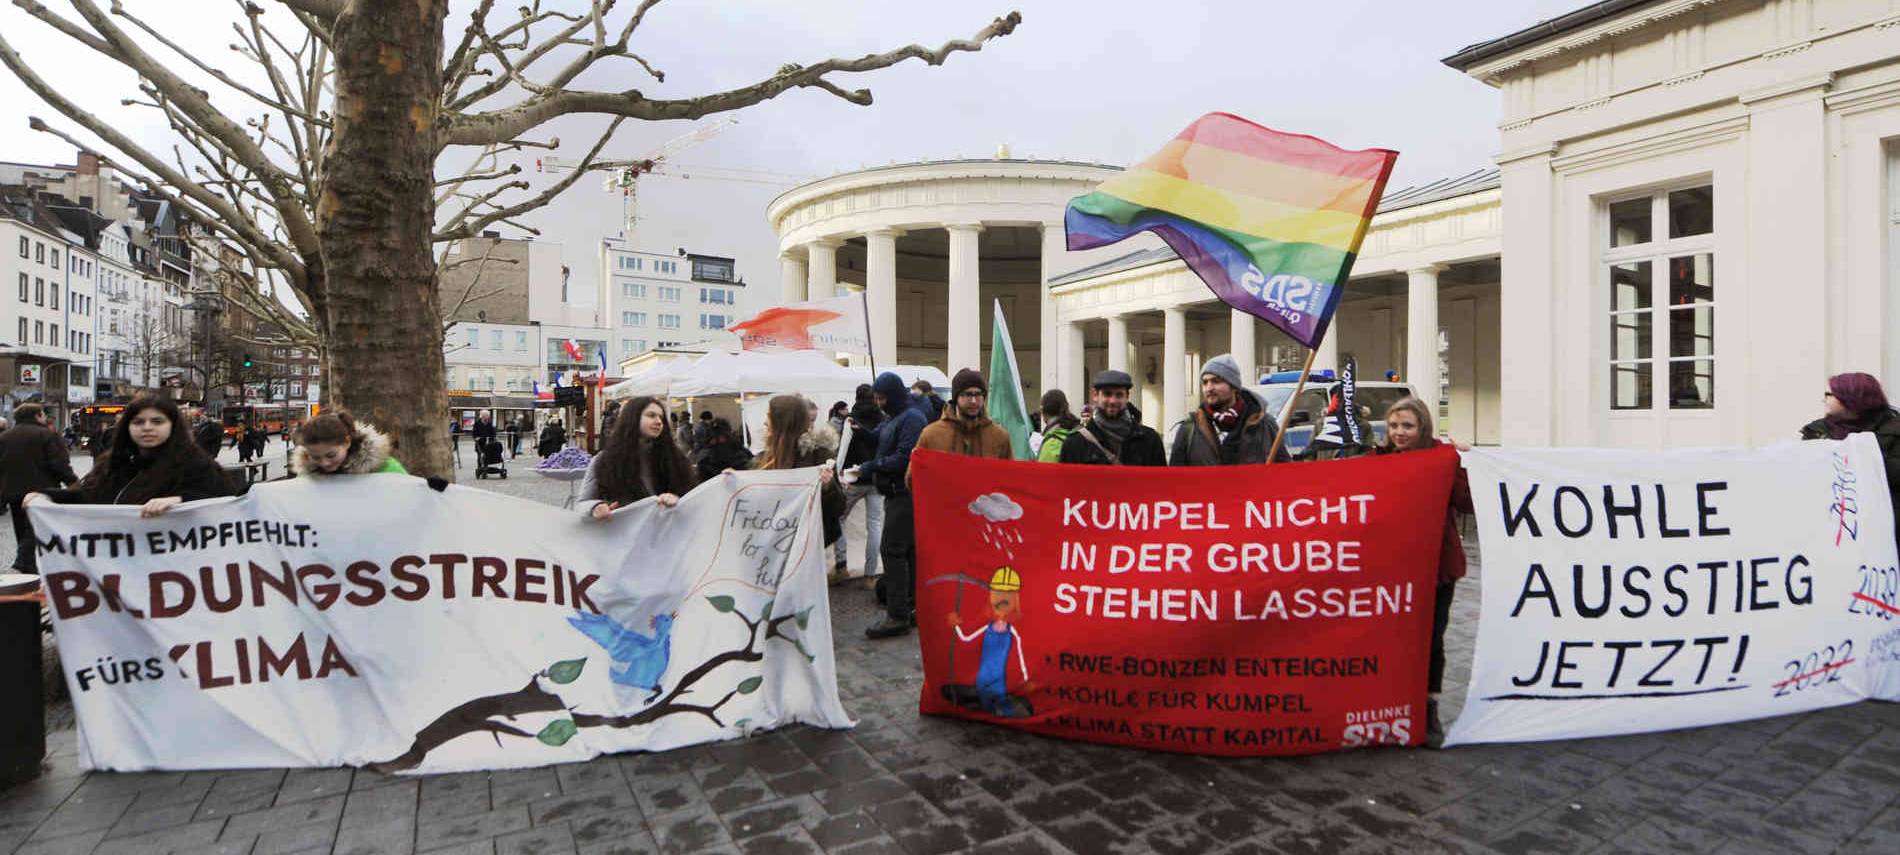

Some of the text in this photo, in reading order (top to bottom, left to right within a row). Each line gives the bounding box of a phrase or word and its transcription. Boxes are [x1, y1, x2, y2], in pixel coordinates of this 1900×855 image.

[1063, 494, 1375, 530] KUMPEL NICHT
[1499, 482, 1730, 539] KOHLE
[36, 519, 319, 558] MITTI EMPFIEHLT:
[1061, 540, 1361, 574] IN DER GRUBE
[1054, 582, 1414, 621] STEHEN LASSEN!
[1510, 554, 1814, 619] AUSSTIEG
[75, 656, 164, 692] FÜRS
[1059, 652, 1379, 678] RWE-BONZEN ENTEIGNEN
[1512, 635, 1751, 689] JETZT!
[1773, 639, 1853, 698] 2032
[1147, 689, 1198, 710] FÜR
[1206, 692, 1312, 714] KUMPEL
[1057, 714, 1329, 746] KLIMA STATT KAPITAL
[1341, 718, 1411, 747] SDS
